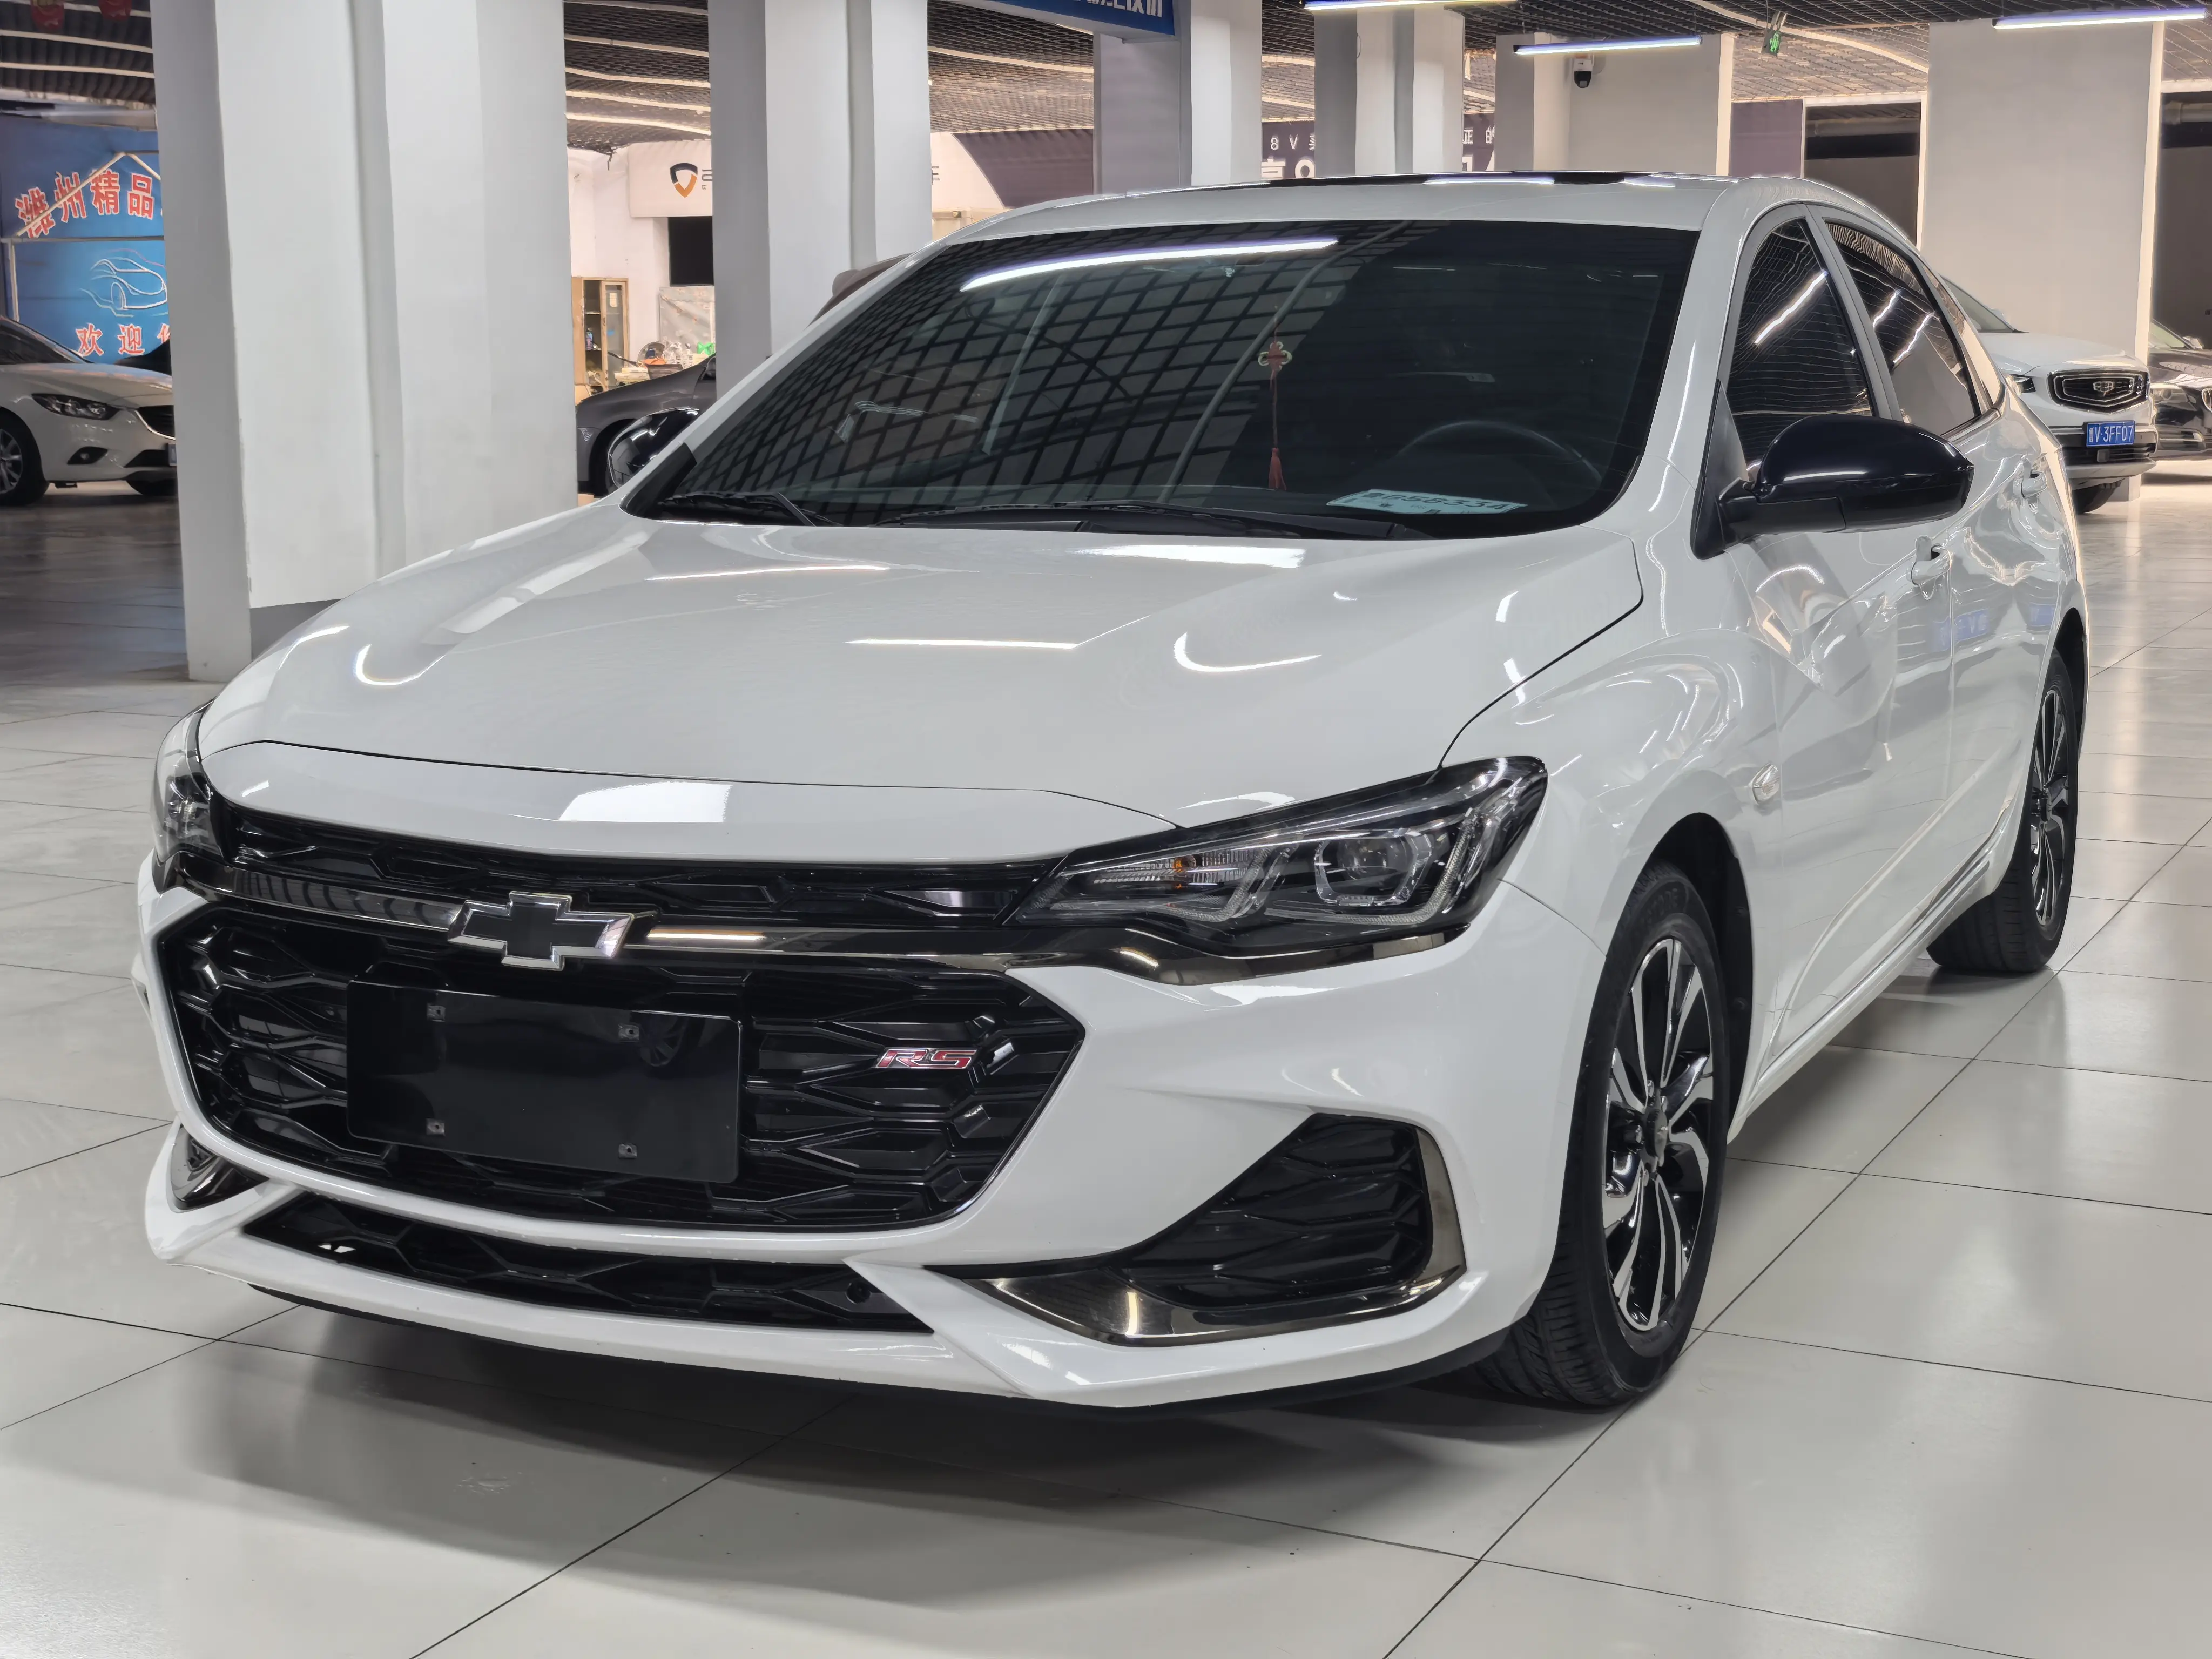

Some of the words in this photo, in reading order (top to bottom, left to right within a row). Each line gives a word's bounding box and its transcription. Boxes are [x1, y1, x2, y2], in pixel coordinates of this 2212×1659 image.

[15, 168, 163, 238] 潍州精品
[875, 1049, 977, 1069] RS
